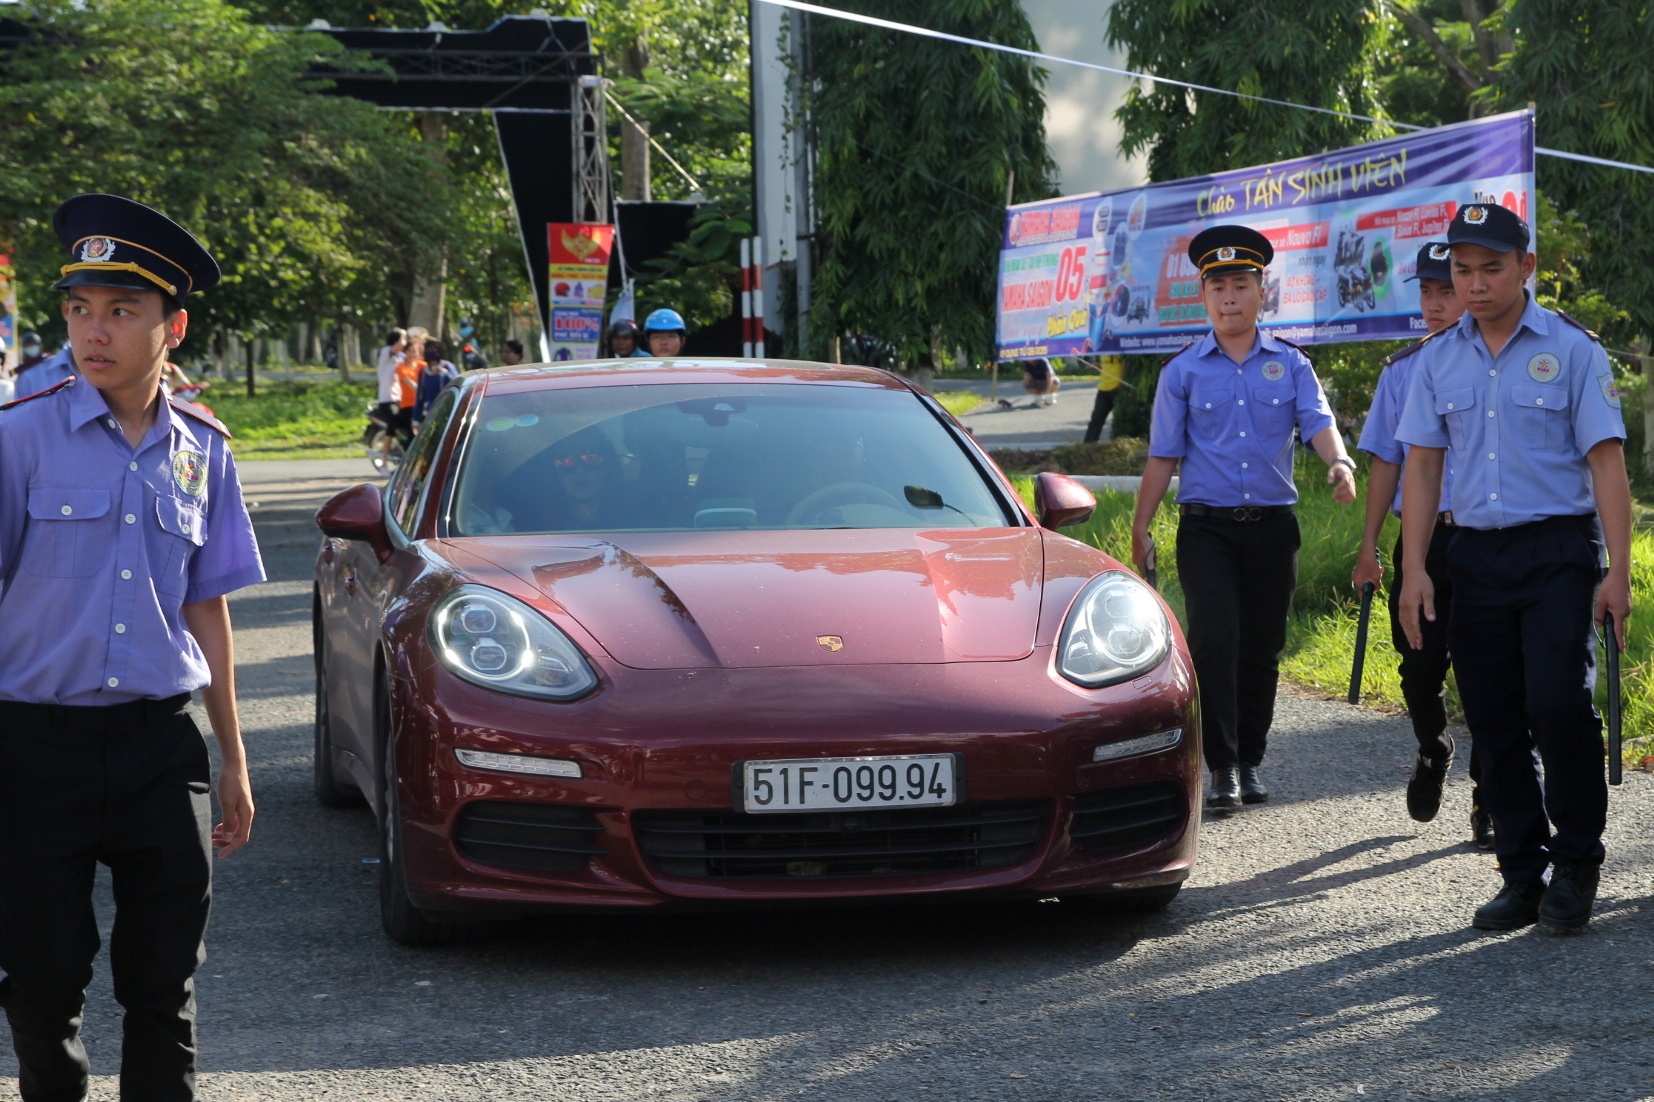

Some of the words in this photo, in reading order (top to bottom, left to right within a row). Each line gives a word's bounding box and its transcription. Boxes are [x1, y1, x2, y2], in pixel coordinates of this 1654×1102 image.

[1197, 186, 1235, 217] Chào
[1240, 168, 1287, 211] TÂN
[1288, 161, 1343, 205] SINH
[1351, 147, 1408, 193] VIÊN
[1055, 246, 1087, 303] 05
[1410, 317, 1428, 330] Face
[753, 762, 947, 806] 51F-099.94
